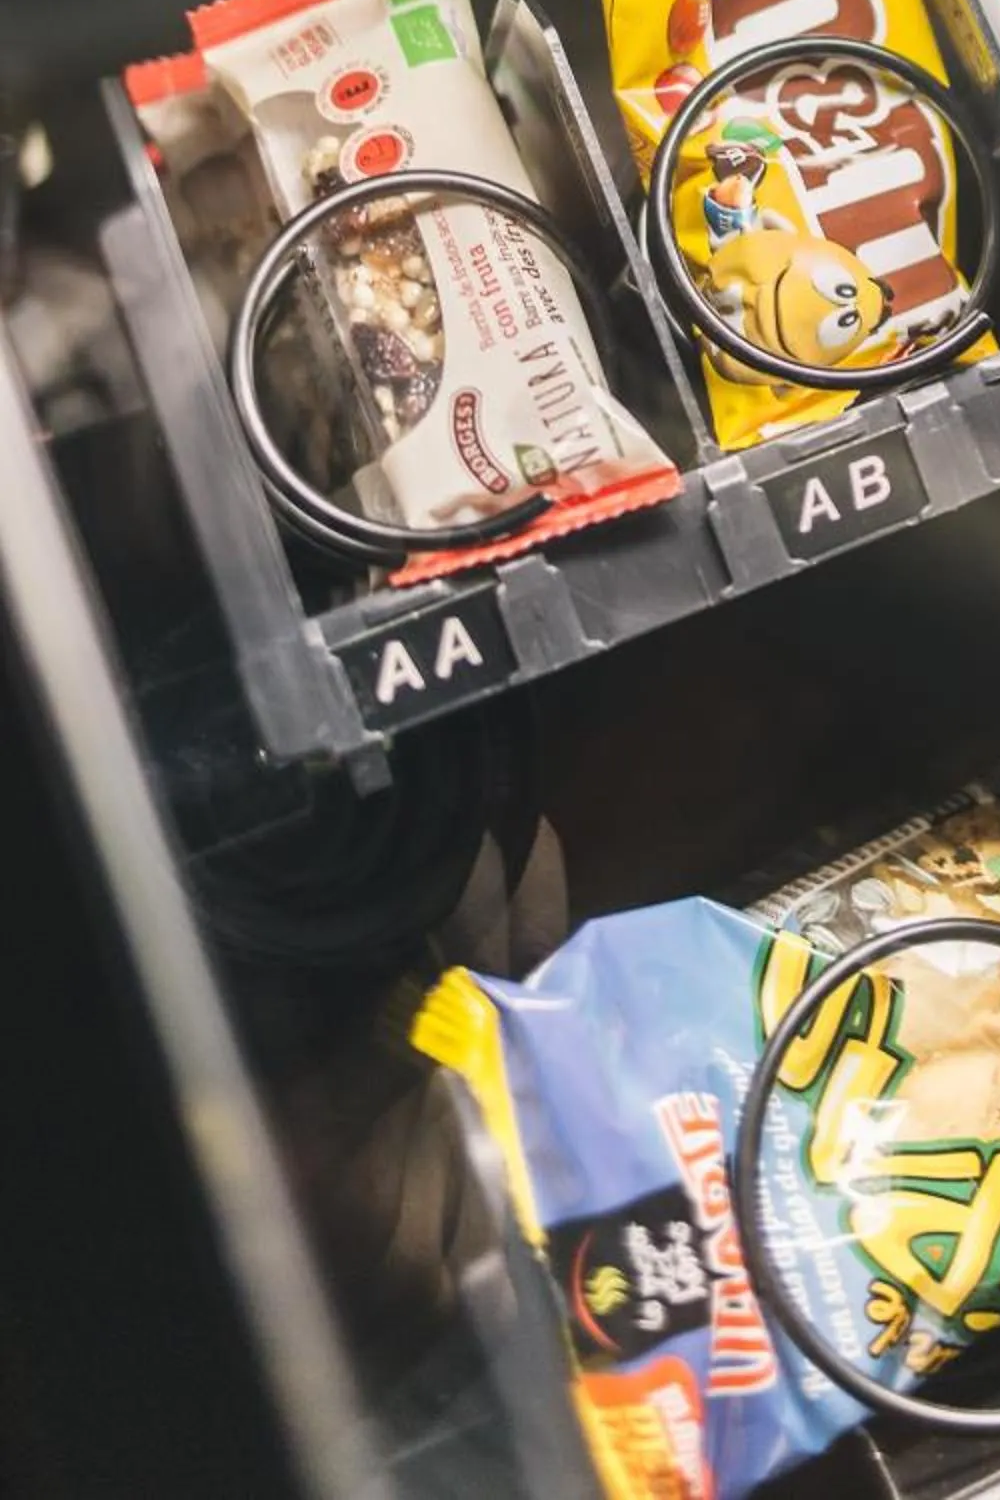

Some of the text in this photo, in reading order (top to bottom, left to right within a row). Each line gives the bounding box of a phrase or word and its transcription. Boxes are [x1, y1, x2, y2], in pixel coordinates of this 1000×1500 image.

[469, 243, 519, 340] con fruta
[534, 283, 566, 324] avec
[457, 405, 499, 490] BORGES
[519, 340, 604, 476] NATURA
[797, 454, 893, 534] AB
[377, 617, 483, 703] AA
